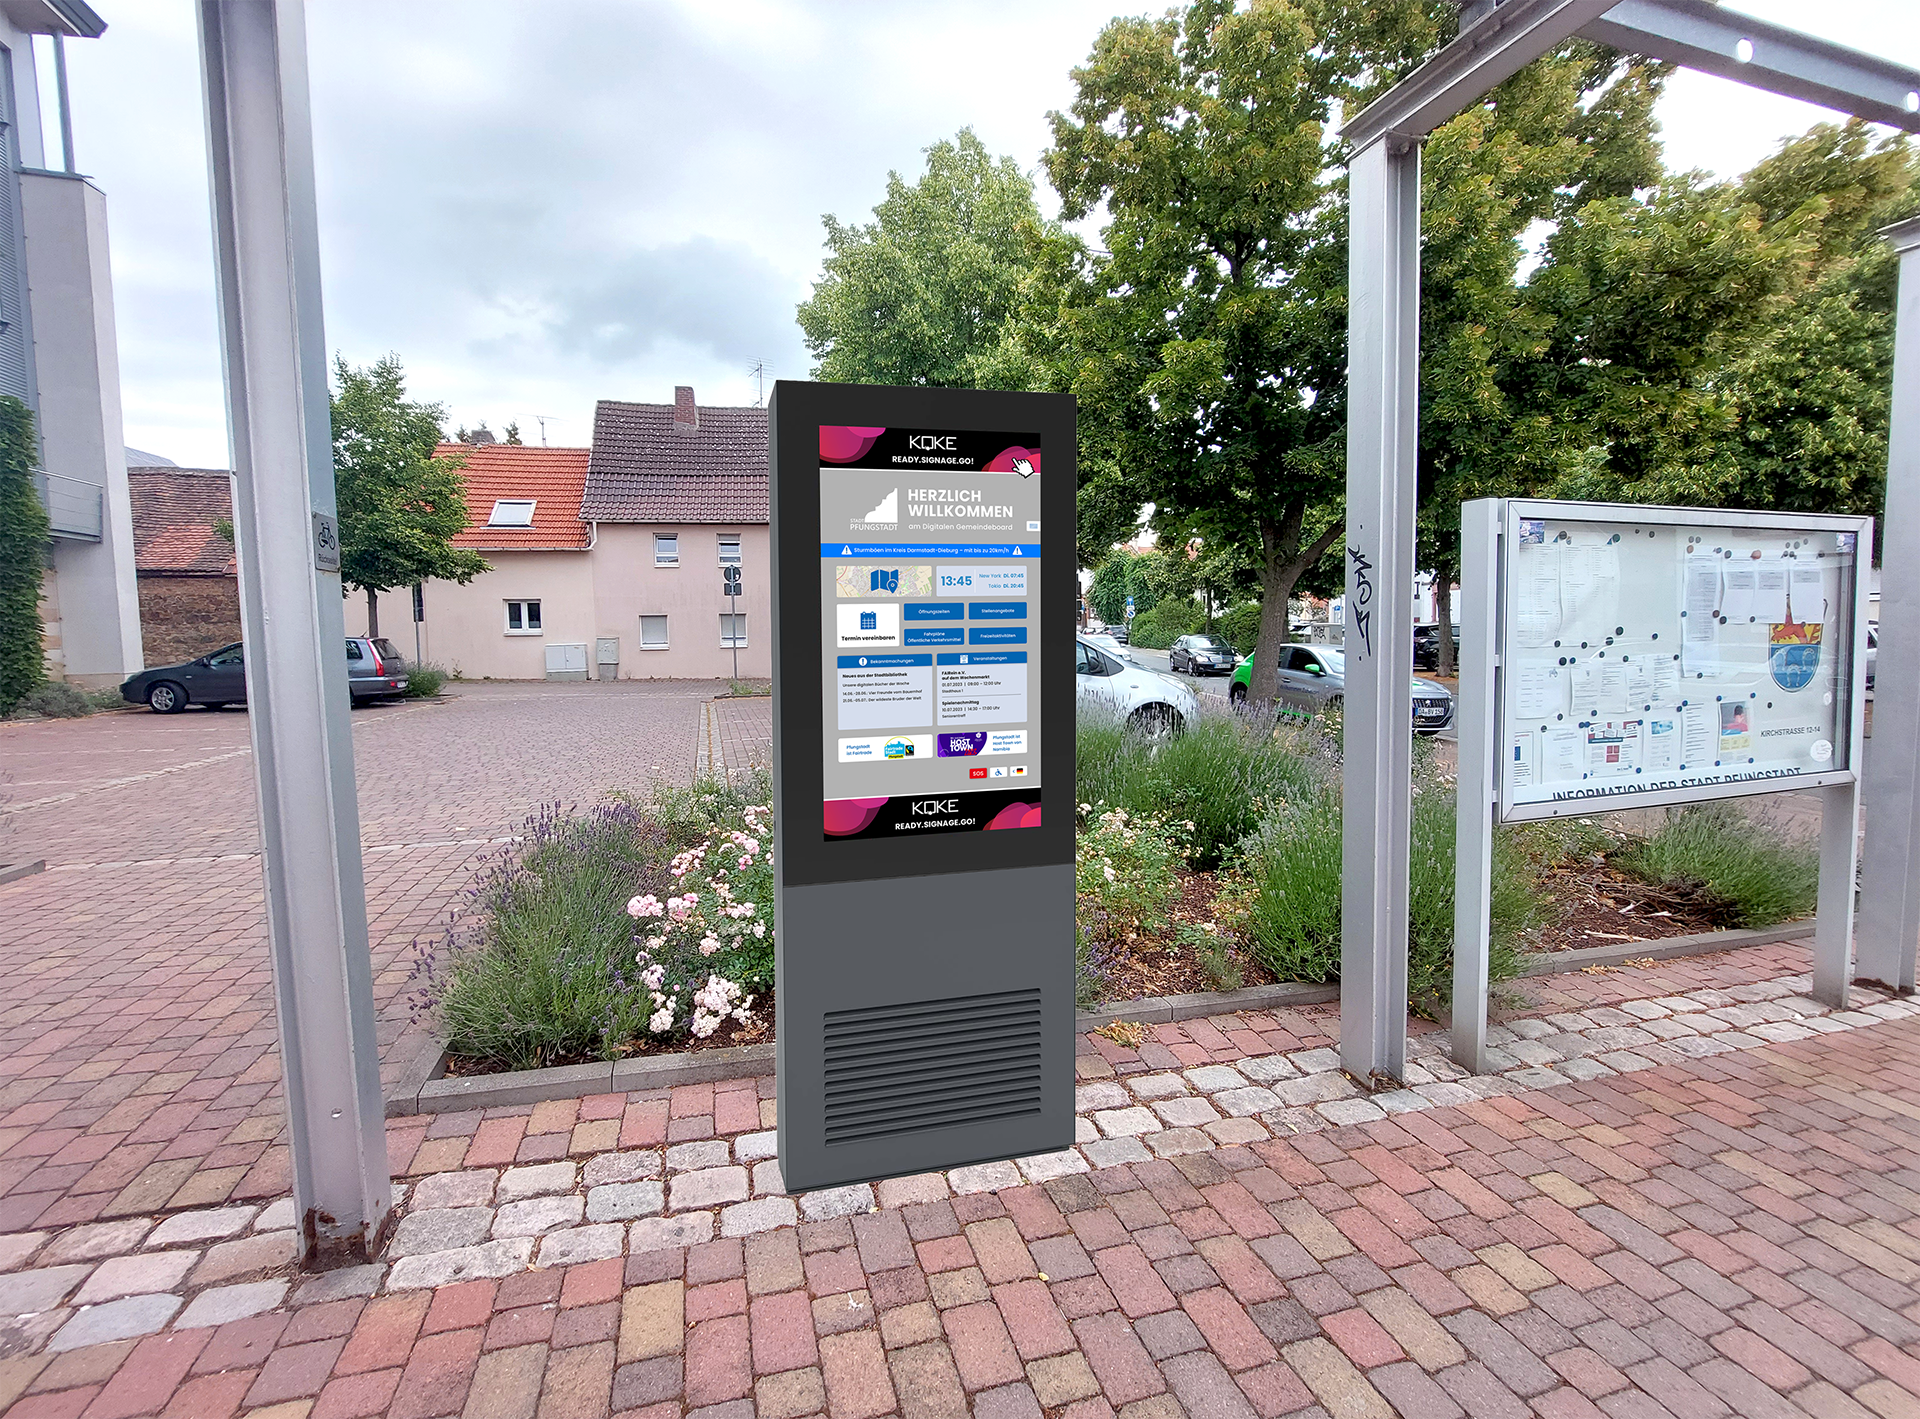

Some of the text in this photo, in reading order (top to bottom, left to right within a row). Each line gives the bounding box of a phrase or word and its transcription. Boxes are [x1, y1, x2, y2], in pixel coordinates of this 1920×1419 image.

[892, 456, 974, 465] READY.SIGNAGE.GO!
[908, 489, 981, 502] HERZLICH
[908, 504, 1013, 518] WILLKOMMEN
[922, 523, 954, 532] Digitalen
[956, 523, 1013, 531] Gemeindeboard
[940, 575, 972, 586] 13:45
[1760, 727, 1805, 737] KIRCHSTRASSE
[950, 744, 974, 752] TOWN
[895, 818, 976, 830] READY.SIGNAGE.GO!
